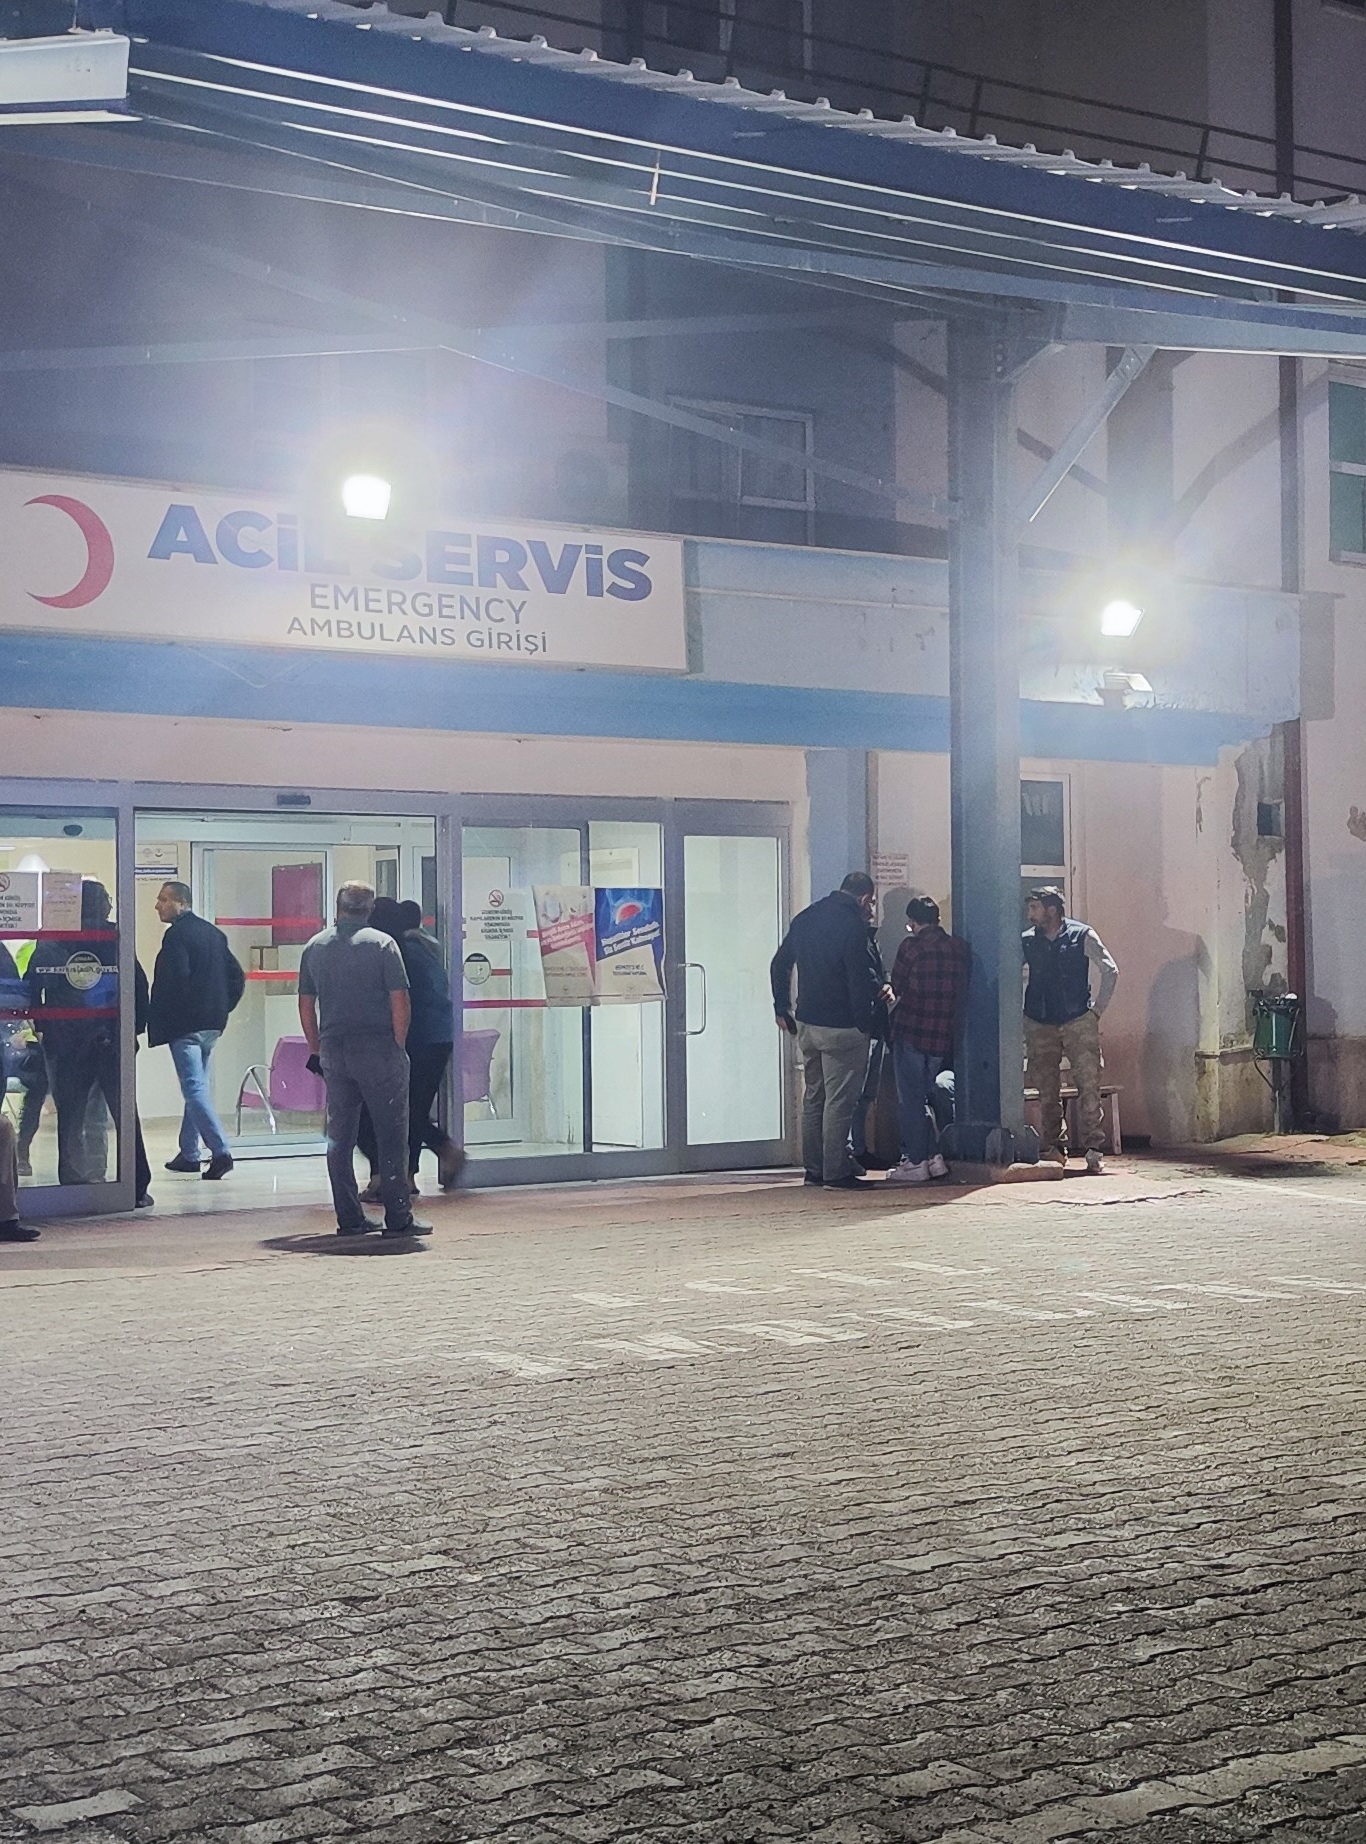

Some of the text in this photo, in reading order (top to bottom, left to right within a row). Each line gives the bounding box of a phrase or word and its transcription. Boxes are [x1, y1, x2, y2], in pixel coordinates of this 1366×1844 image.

[310, 582, 528, 625] EMERGENCY
[286, 616, 548, 655] AMBULANS GİRİŞİ
